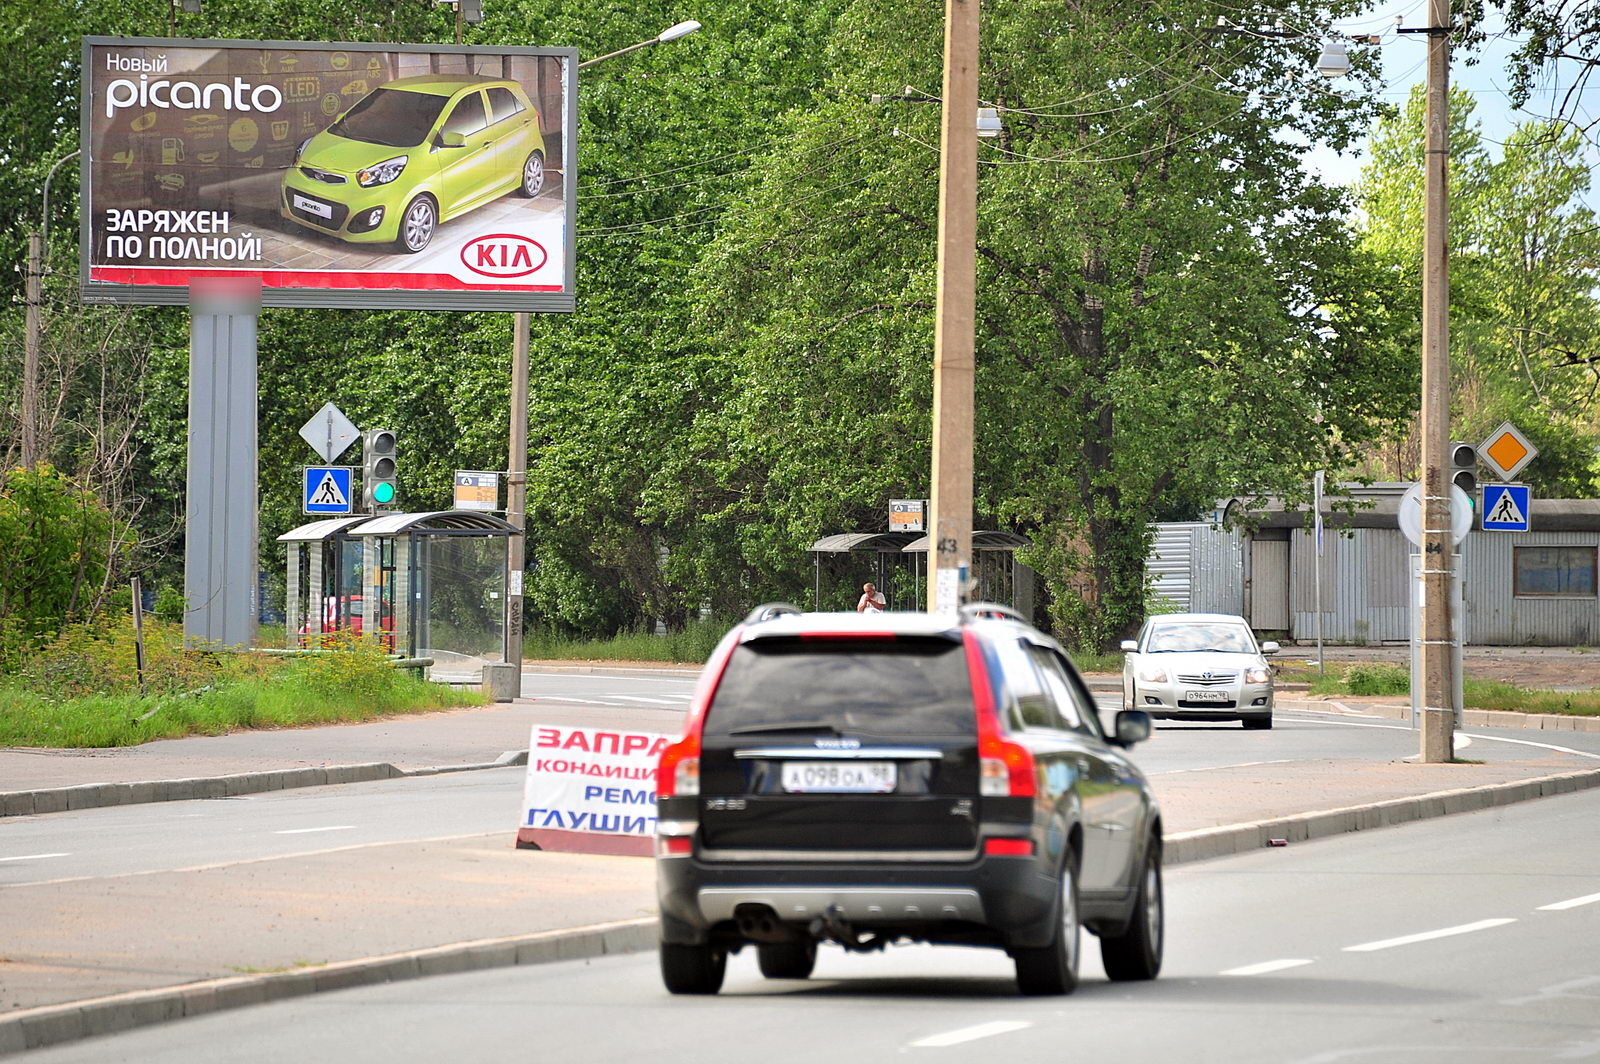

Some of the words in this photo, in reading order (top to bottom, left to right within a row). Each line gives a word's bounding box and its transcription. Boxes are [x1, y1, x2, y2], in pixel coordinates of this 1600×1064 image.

[106, 53, 168, 73] Новый
[106, 74, 282, 118] picanto
[289, 82, 315, 98] LED
[301, 201, 321, 212] picanto
[106, 209, 229, 234] ЗАРЯЖЕН
[106, 236, 142, 259] ПО
[149, 232, 262, 261] ПОЛНОЙ!
[477, 244, 533, 267] KIA
[937, 538, 957, 554] 43
